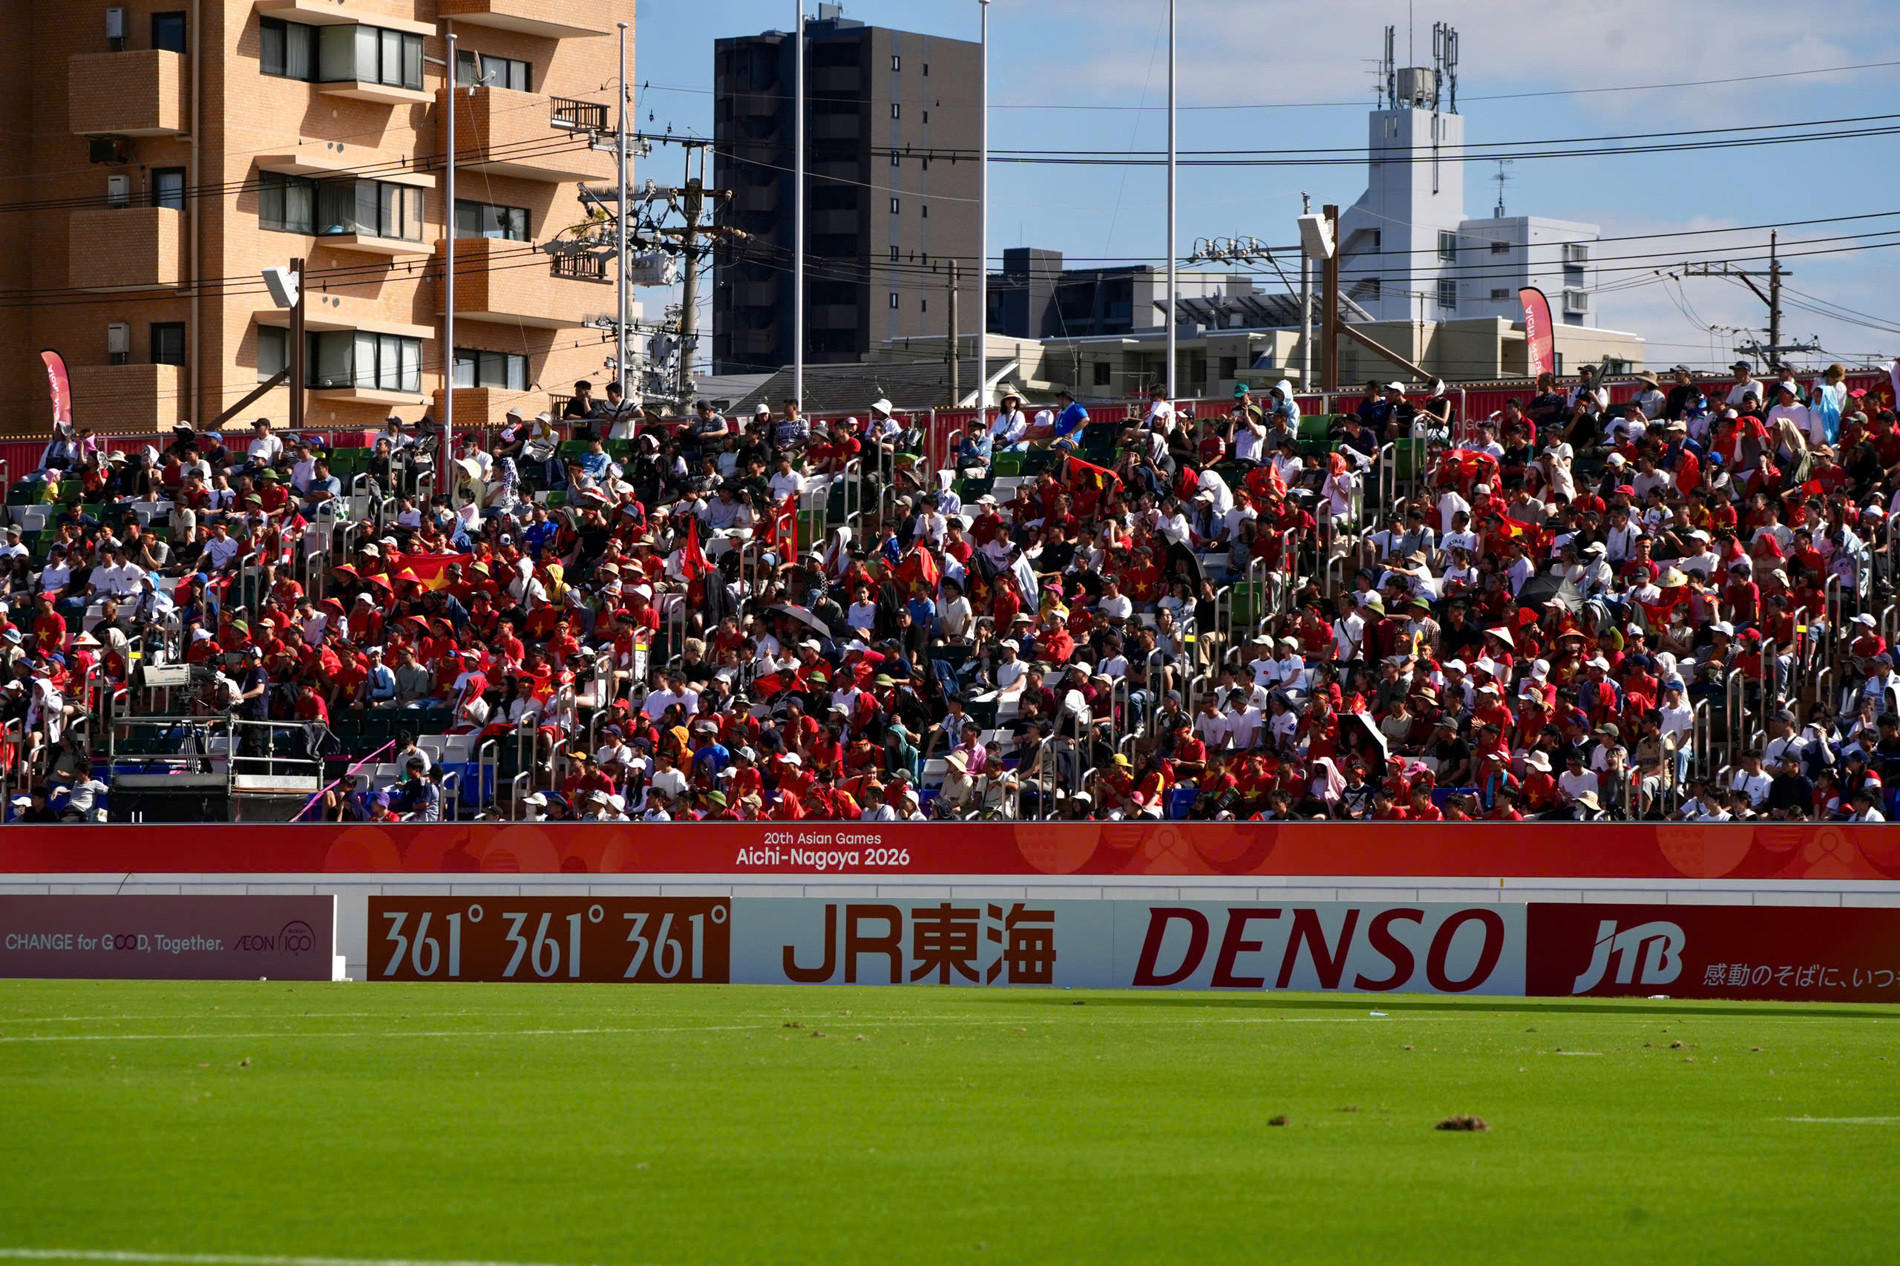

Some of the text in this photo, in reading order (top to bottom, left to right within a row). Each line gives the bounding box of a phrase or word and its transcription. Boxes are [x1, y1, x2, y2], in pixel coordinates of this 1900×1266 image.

[764, 831, 882, 845] 20th Asian Games
[736, 847, 910, 871] Aichi-Nagoya 2026
[5, 933, 74, 951] CHANGE
[77, 933, 98, 951] for
[155, 933, 225, 954] Together.
[782, 902, 1057, 985] JR東海
[1132, 907, 1505, 993] DENSO
[1572, 920, 1686, 994] JTB
[1703, 962, 1900, 988] 感動のそばに、いつ
